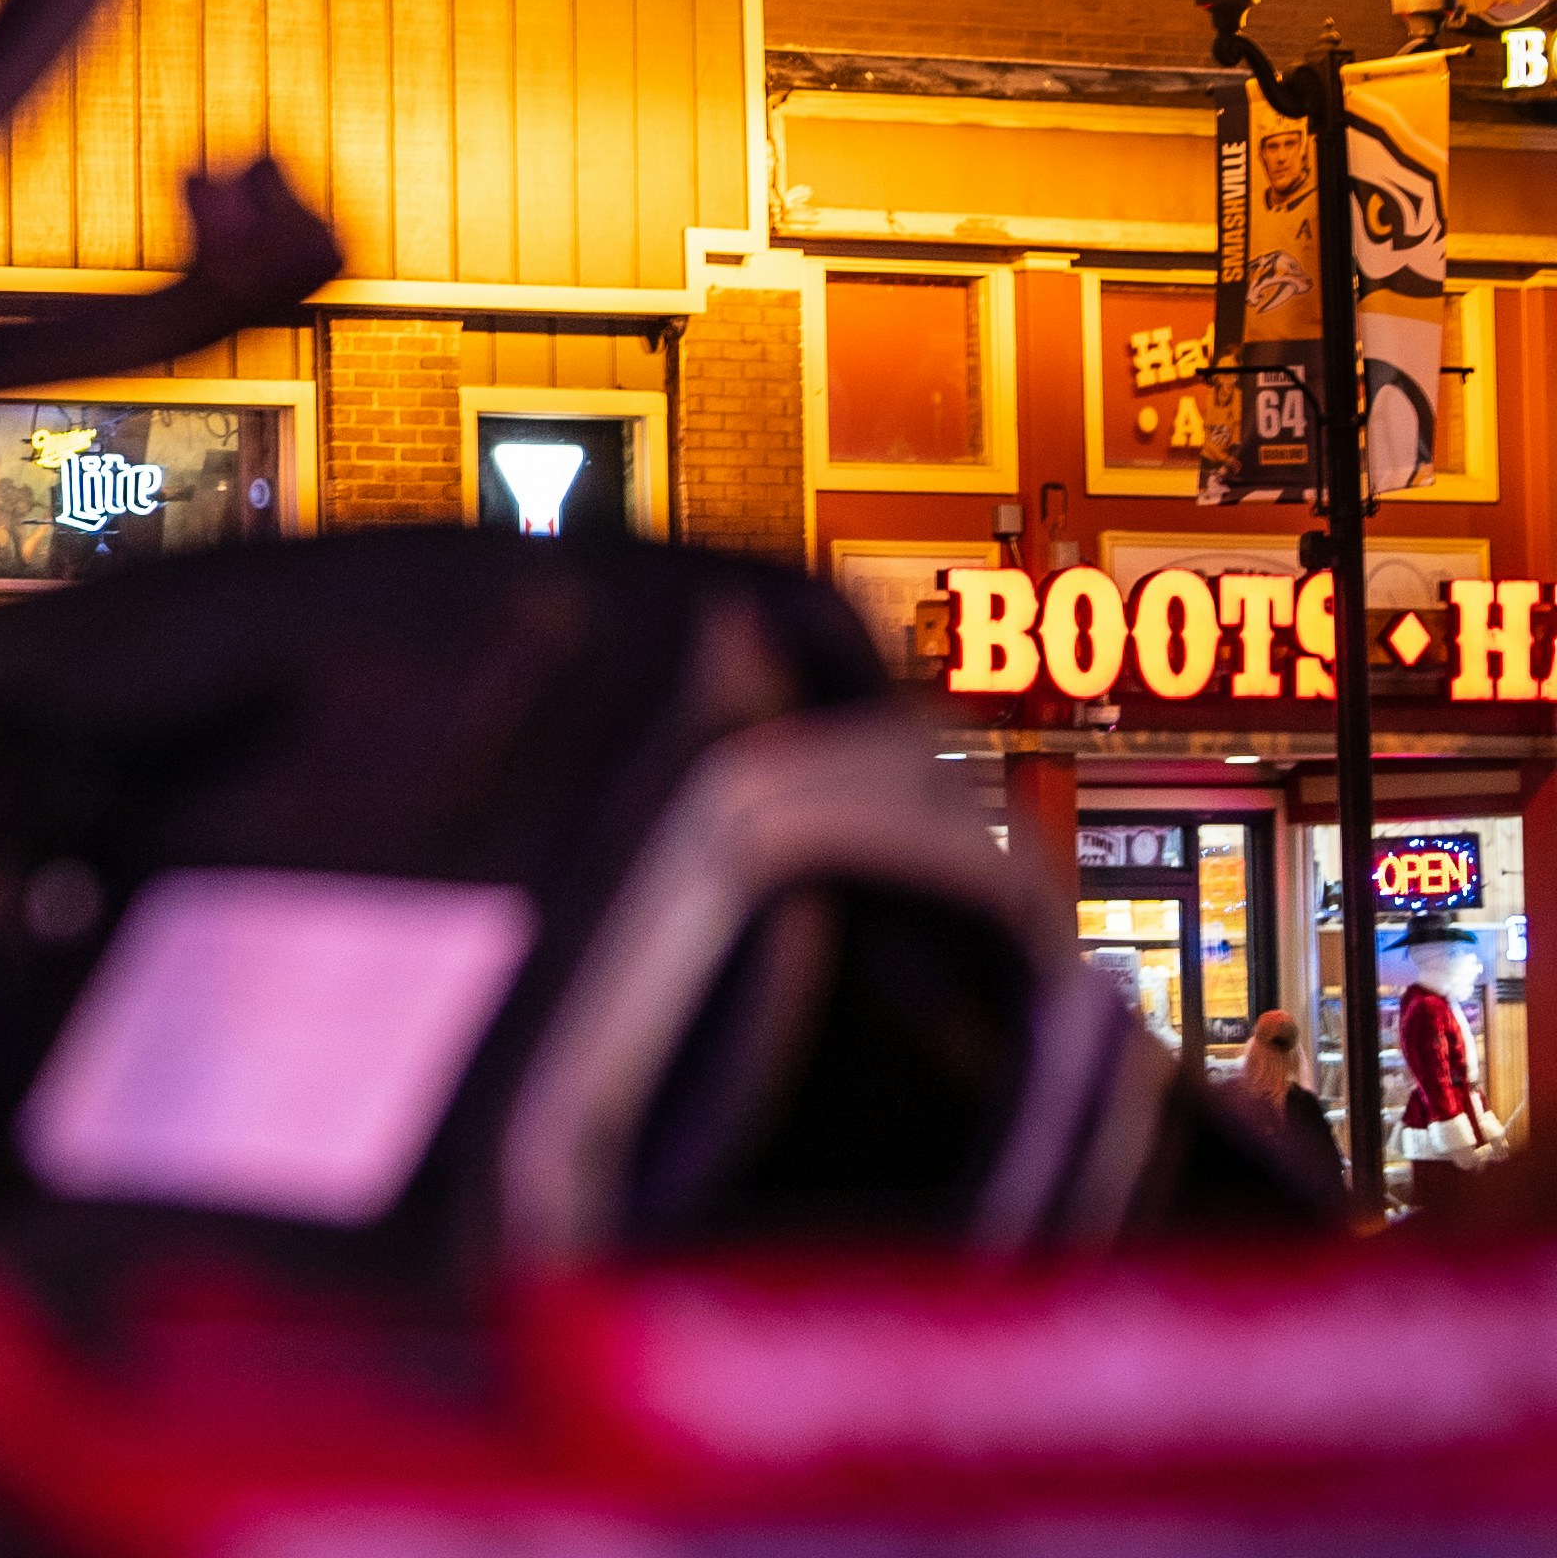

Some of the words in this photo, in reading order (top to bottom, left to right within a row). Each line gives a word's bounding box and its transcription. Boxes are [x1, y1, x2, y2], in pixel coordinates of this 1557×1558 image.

[1221, 140, 1247, 285] SMASHVILLE
[1256, 389, 1307, 439] 64
[55, 453, 164, 532] Lite
[949, 566, 1337, 699] BOOTS
[1377, 853, 1469, 896] OPEN
